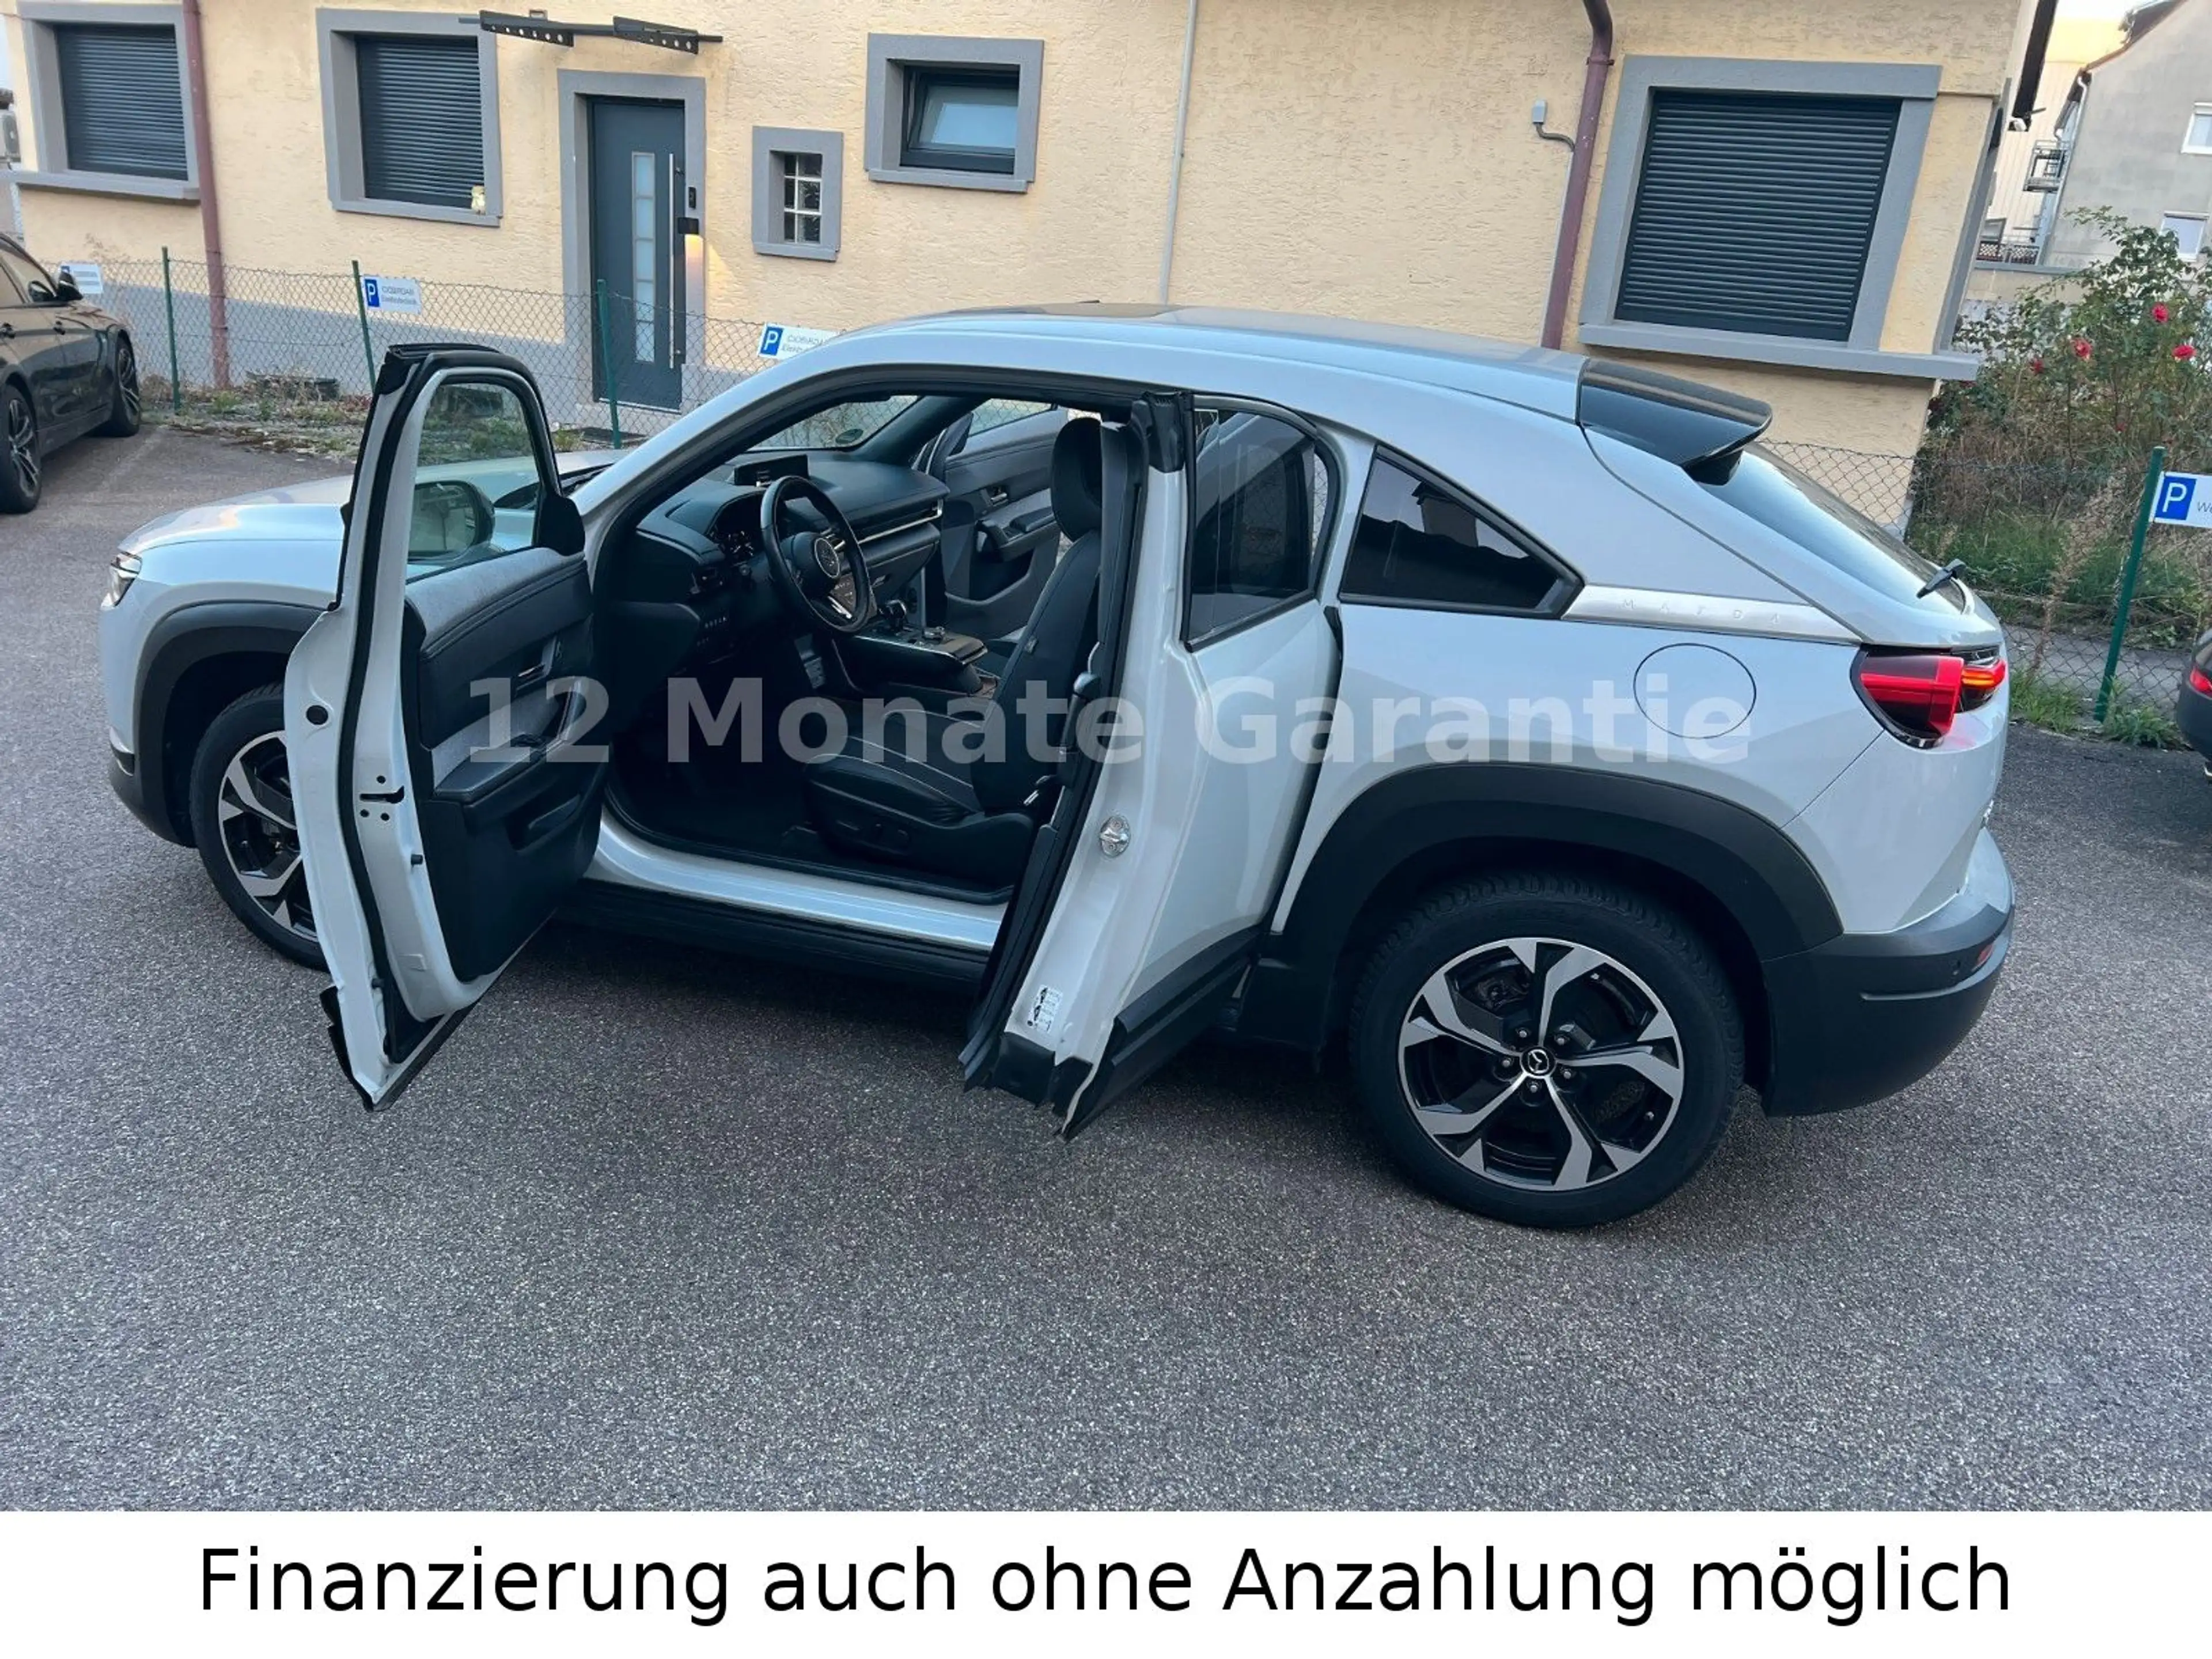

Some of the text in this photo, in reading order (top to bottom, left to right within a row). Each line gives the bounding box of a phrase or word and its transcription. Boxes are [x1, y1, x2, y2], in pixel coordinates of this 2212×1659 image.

[367, 283, 376, 302] P
[763, 330, 779, 350] P
[2162, 482, 2187, 513] P
